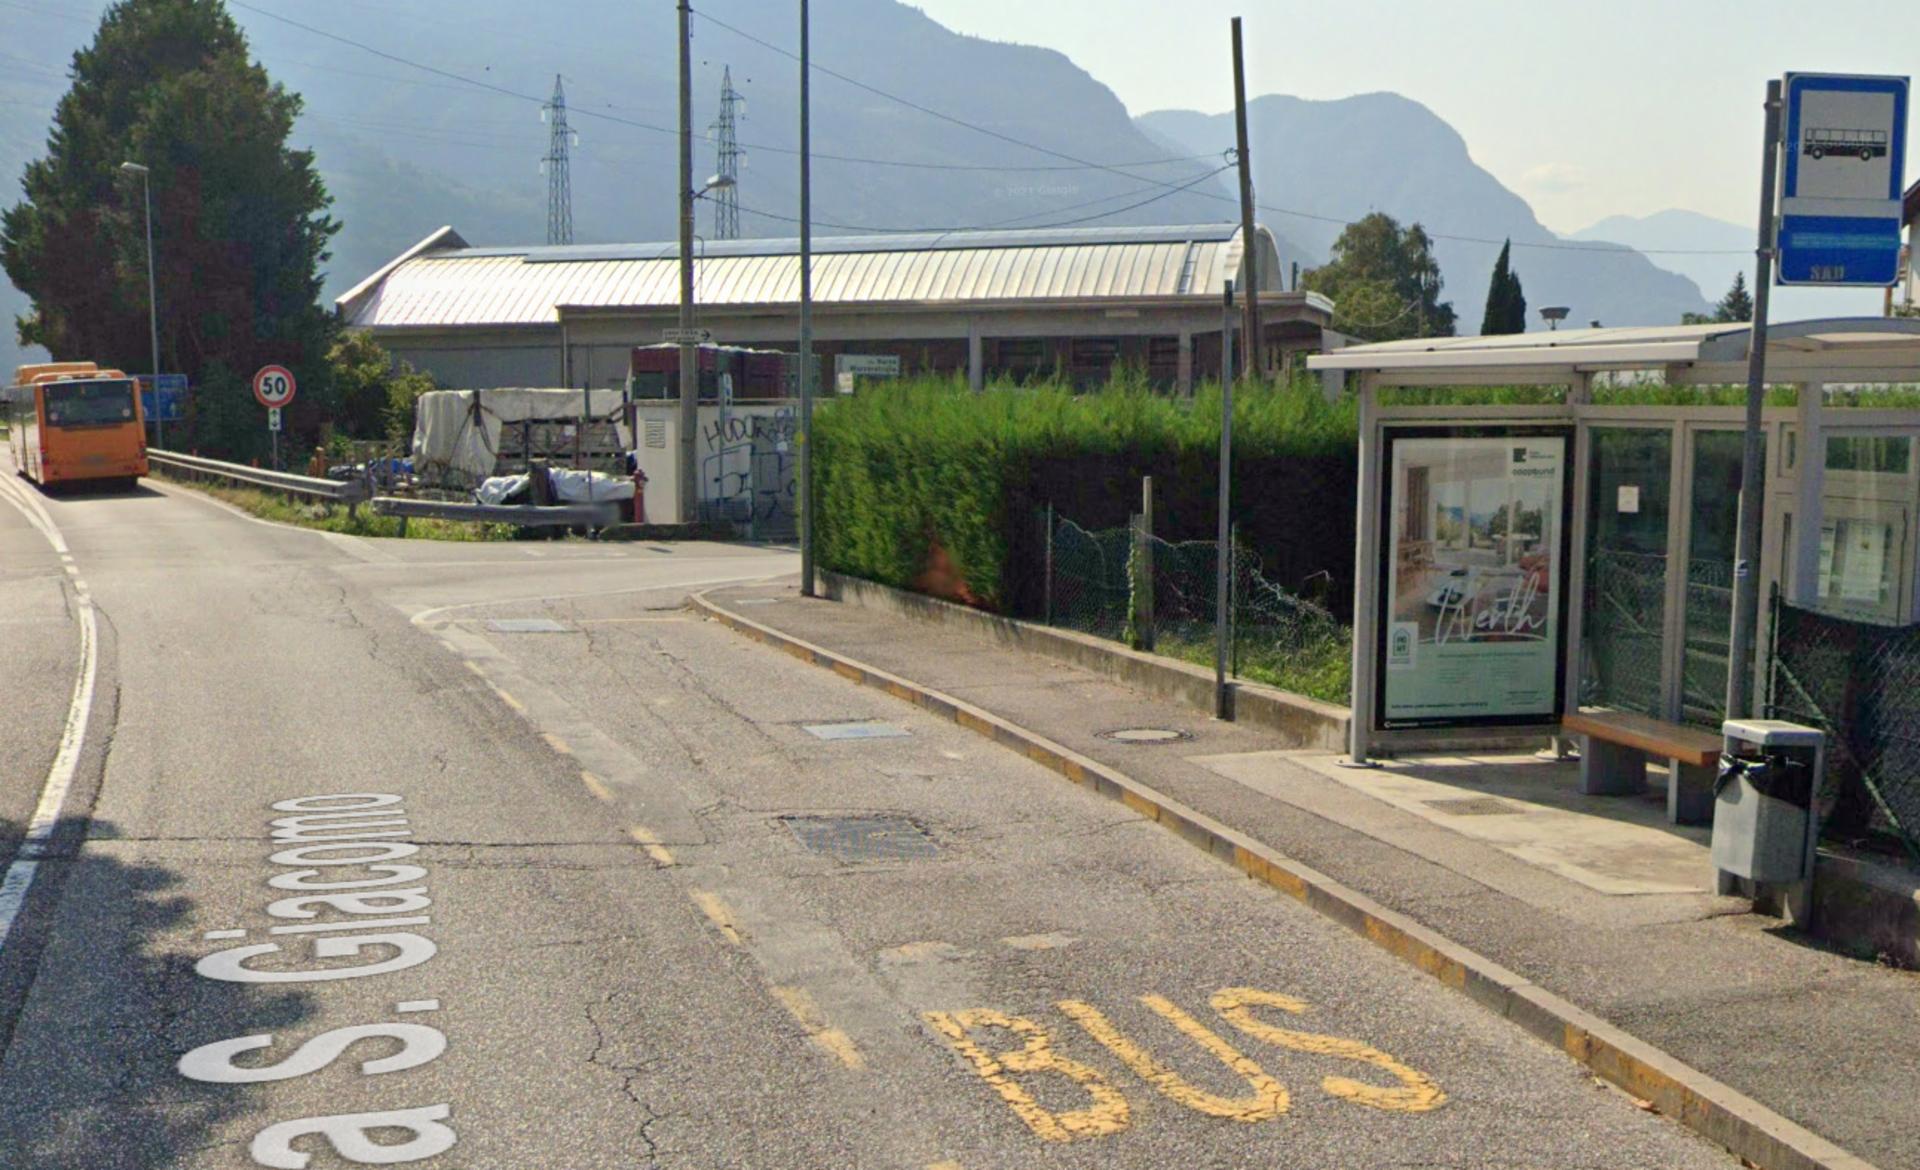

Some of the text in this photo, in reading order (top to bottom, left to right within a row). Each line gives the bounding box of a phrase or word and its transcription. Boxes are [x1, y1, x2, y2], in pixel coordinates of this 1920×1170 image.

[262, 376, 286, 395] 50
[1435, 571, 1546, 647] Werth
[195, 792, 437, 982] Giacomo
[178, 999, 447, 1083] S.
[921, 986, 1448, 1142] BUS
